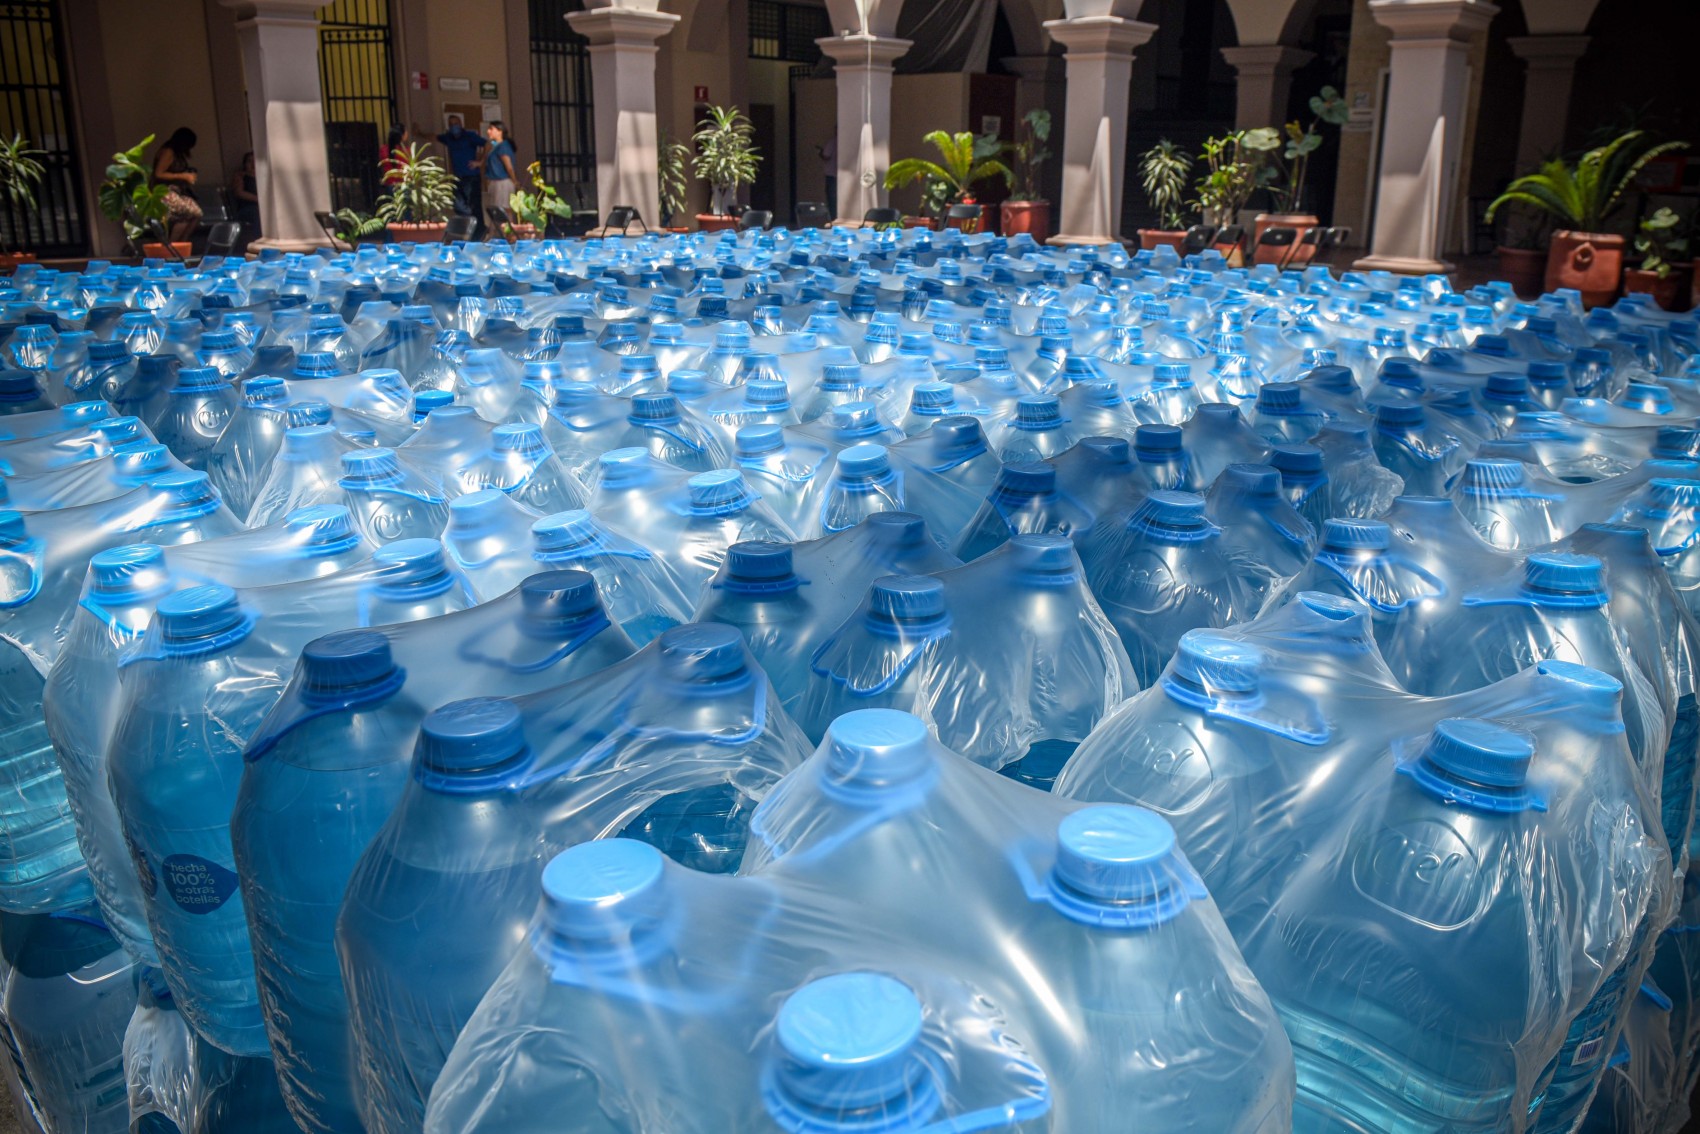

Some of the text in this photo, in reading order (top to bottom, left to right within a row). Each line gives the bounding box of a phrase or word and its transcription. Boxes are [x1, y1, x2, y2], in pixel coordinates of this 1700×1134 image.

[171, 862, 207, 872] hecha
[170, 873, 215, 885] 100%
[185, 886, 215, 894] otras
[176, 894, 221, 904] botellas
